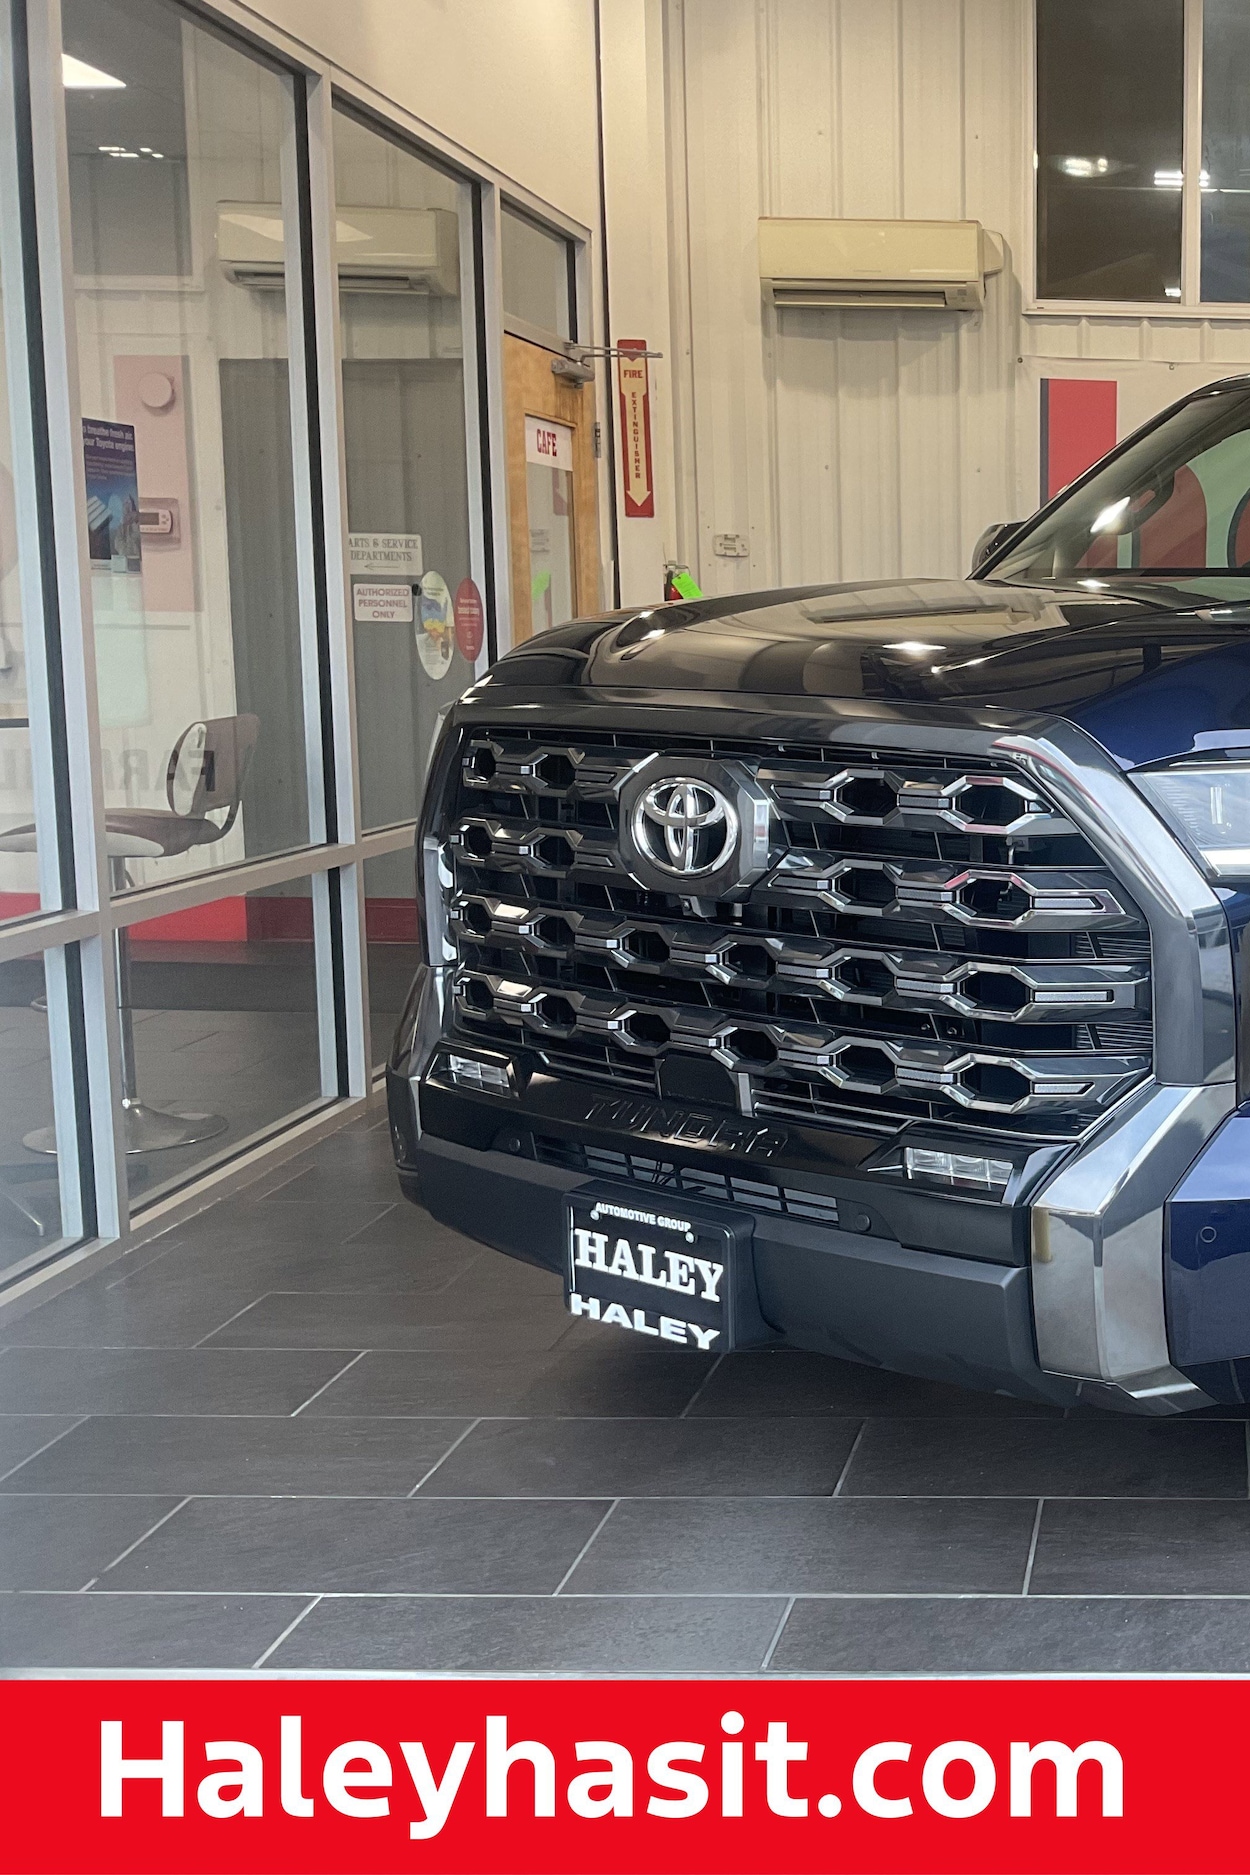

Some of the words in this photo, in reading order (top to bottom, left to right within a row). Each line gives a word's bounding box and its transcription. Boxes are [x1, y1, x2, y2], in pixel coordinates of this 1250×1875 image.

[623, 369, 643, 379] FIRE
[536, 428, 557, 457] CAFE
[631, 391, 641, 479] EXTINGUISHER
[348, 537, 370, 548] ARTS
[372, 538, 379, 548] &
[382, 538, 418, 549] SERVICE
[350, 551, 412, 561] DEPARTMENTS
[356, 588, 410, 597] AUTHORIZED
[358, 599, 408, 608] PERSONNEL
[372, 610, 396, 619] ONLY
[584, 1094, 790, 1158] TUNDRA
[595, 1202, 656, 1226] AUTOMOTIVE
[657, 1214, 692, 1233] GROUP
[574, 1228, 724, 1303] HALEY
[570, 1292, 721, 1350] HALEY
